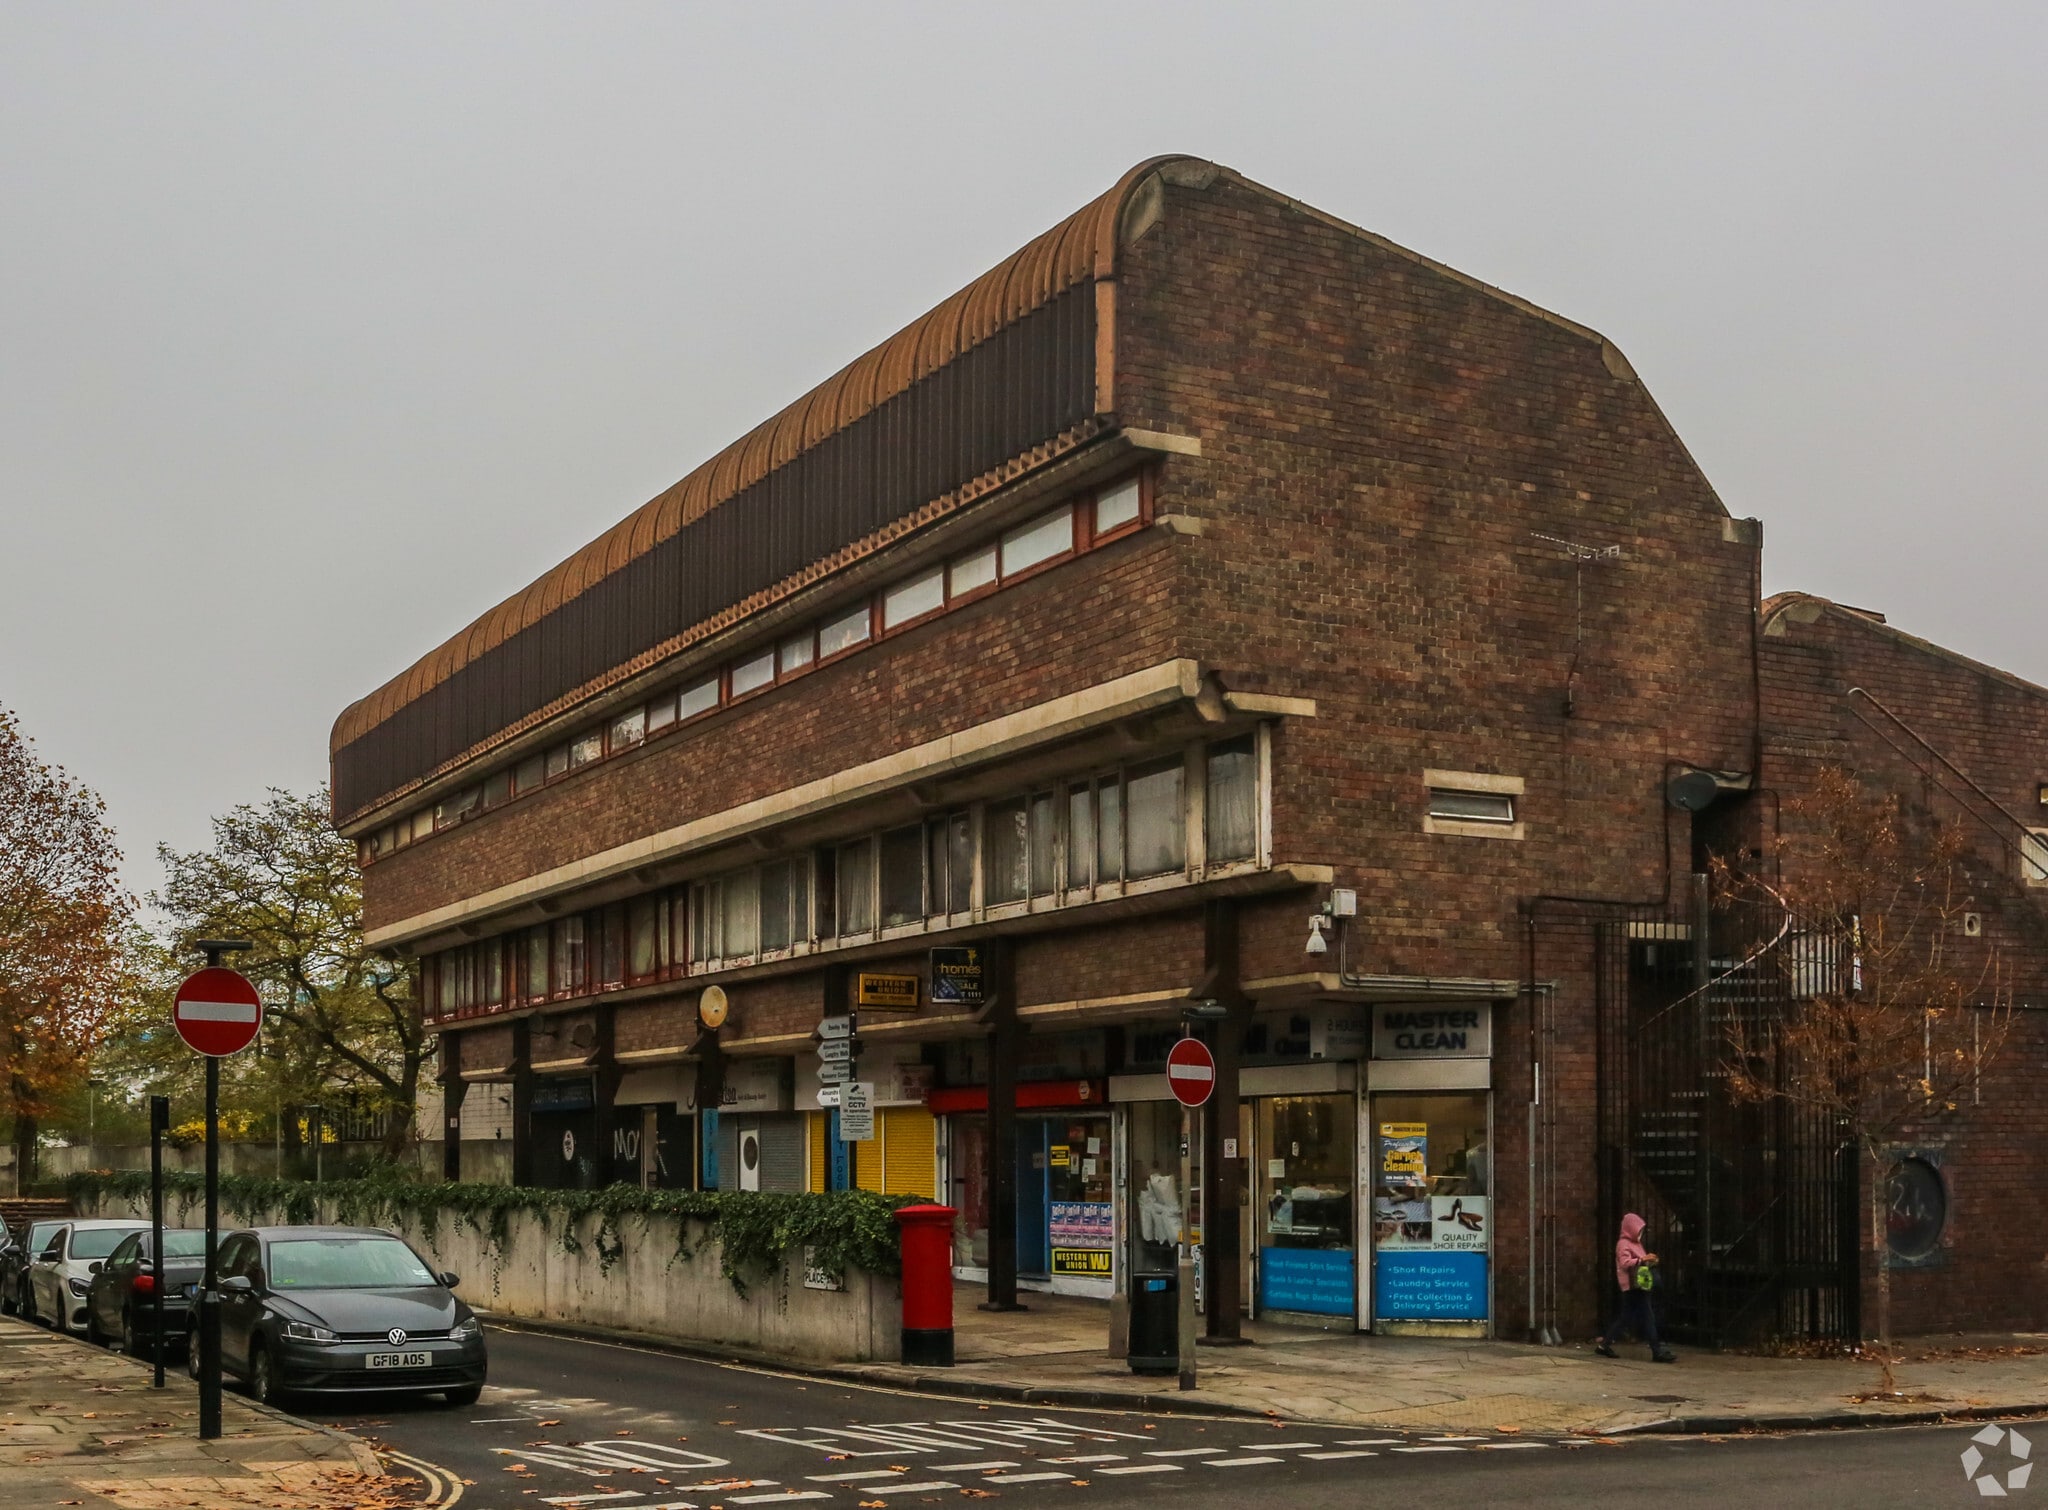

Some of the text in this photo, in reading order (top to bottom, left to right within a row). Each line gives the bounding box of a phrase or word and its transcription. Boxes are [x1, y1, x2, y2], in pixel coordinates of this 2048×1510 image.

[1384, 1010, 1479, 1029] MASTER
[1396, 1032, 1467, 1050] CLEAN
[1387, 1150, 1422, 1162] Carpet
[1384, 1161, 1424, 1173] Cleaning
[1442, 1233, 1478, 1242] QUALITY
[1434, 1242, 1487, 1250] SHOE REPAIRS
[1056, 1252, 1109, 1270] WESTERN WU
[1066, 1261, 1087, 1269] UNION
[1393, 1266, 1456, 1274] Shoe Repairs
[1393, 1279, 1470, 1288] Laundry Service
[1417, 1292, 1462, 1301] Collection
[1393, 1302, 1470, 1311] Delivery Service
[373, 1354, 425, 1366] GF18 AOS
[735, 1418, 1157, 1457] ENTRY
[488, 1440, 732, 1477] NO
